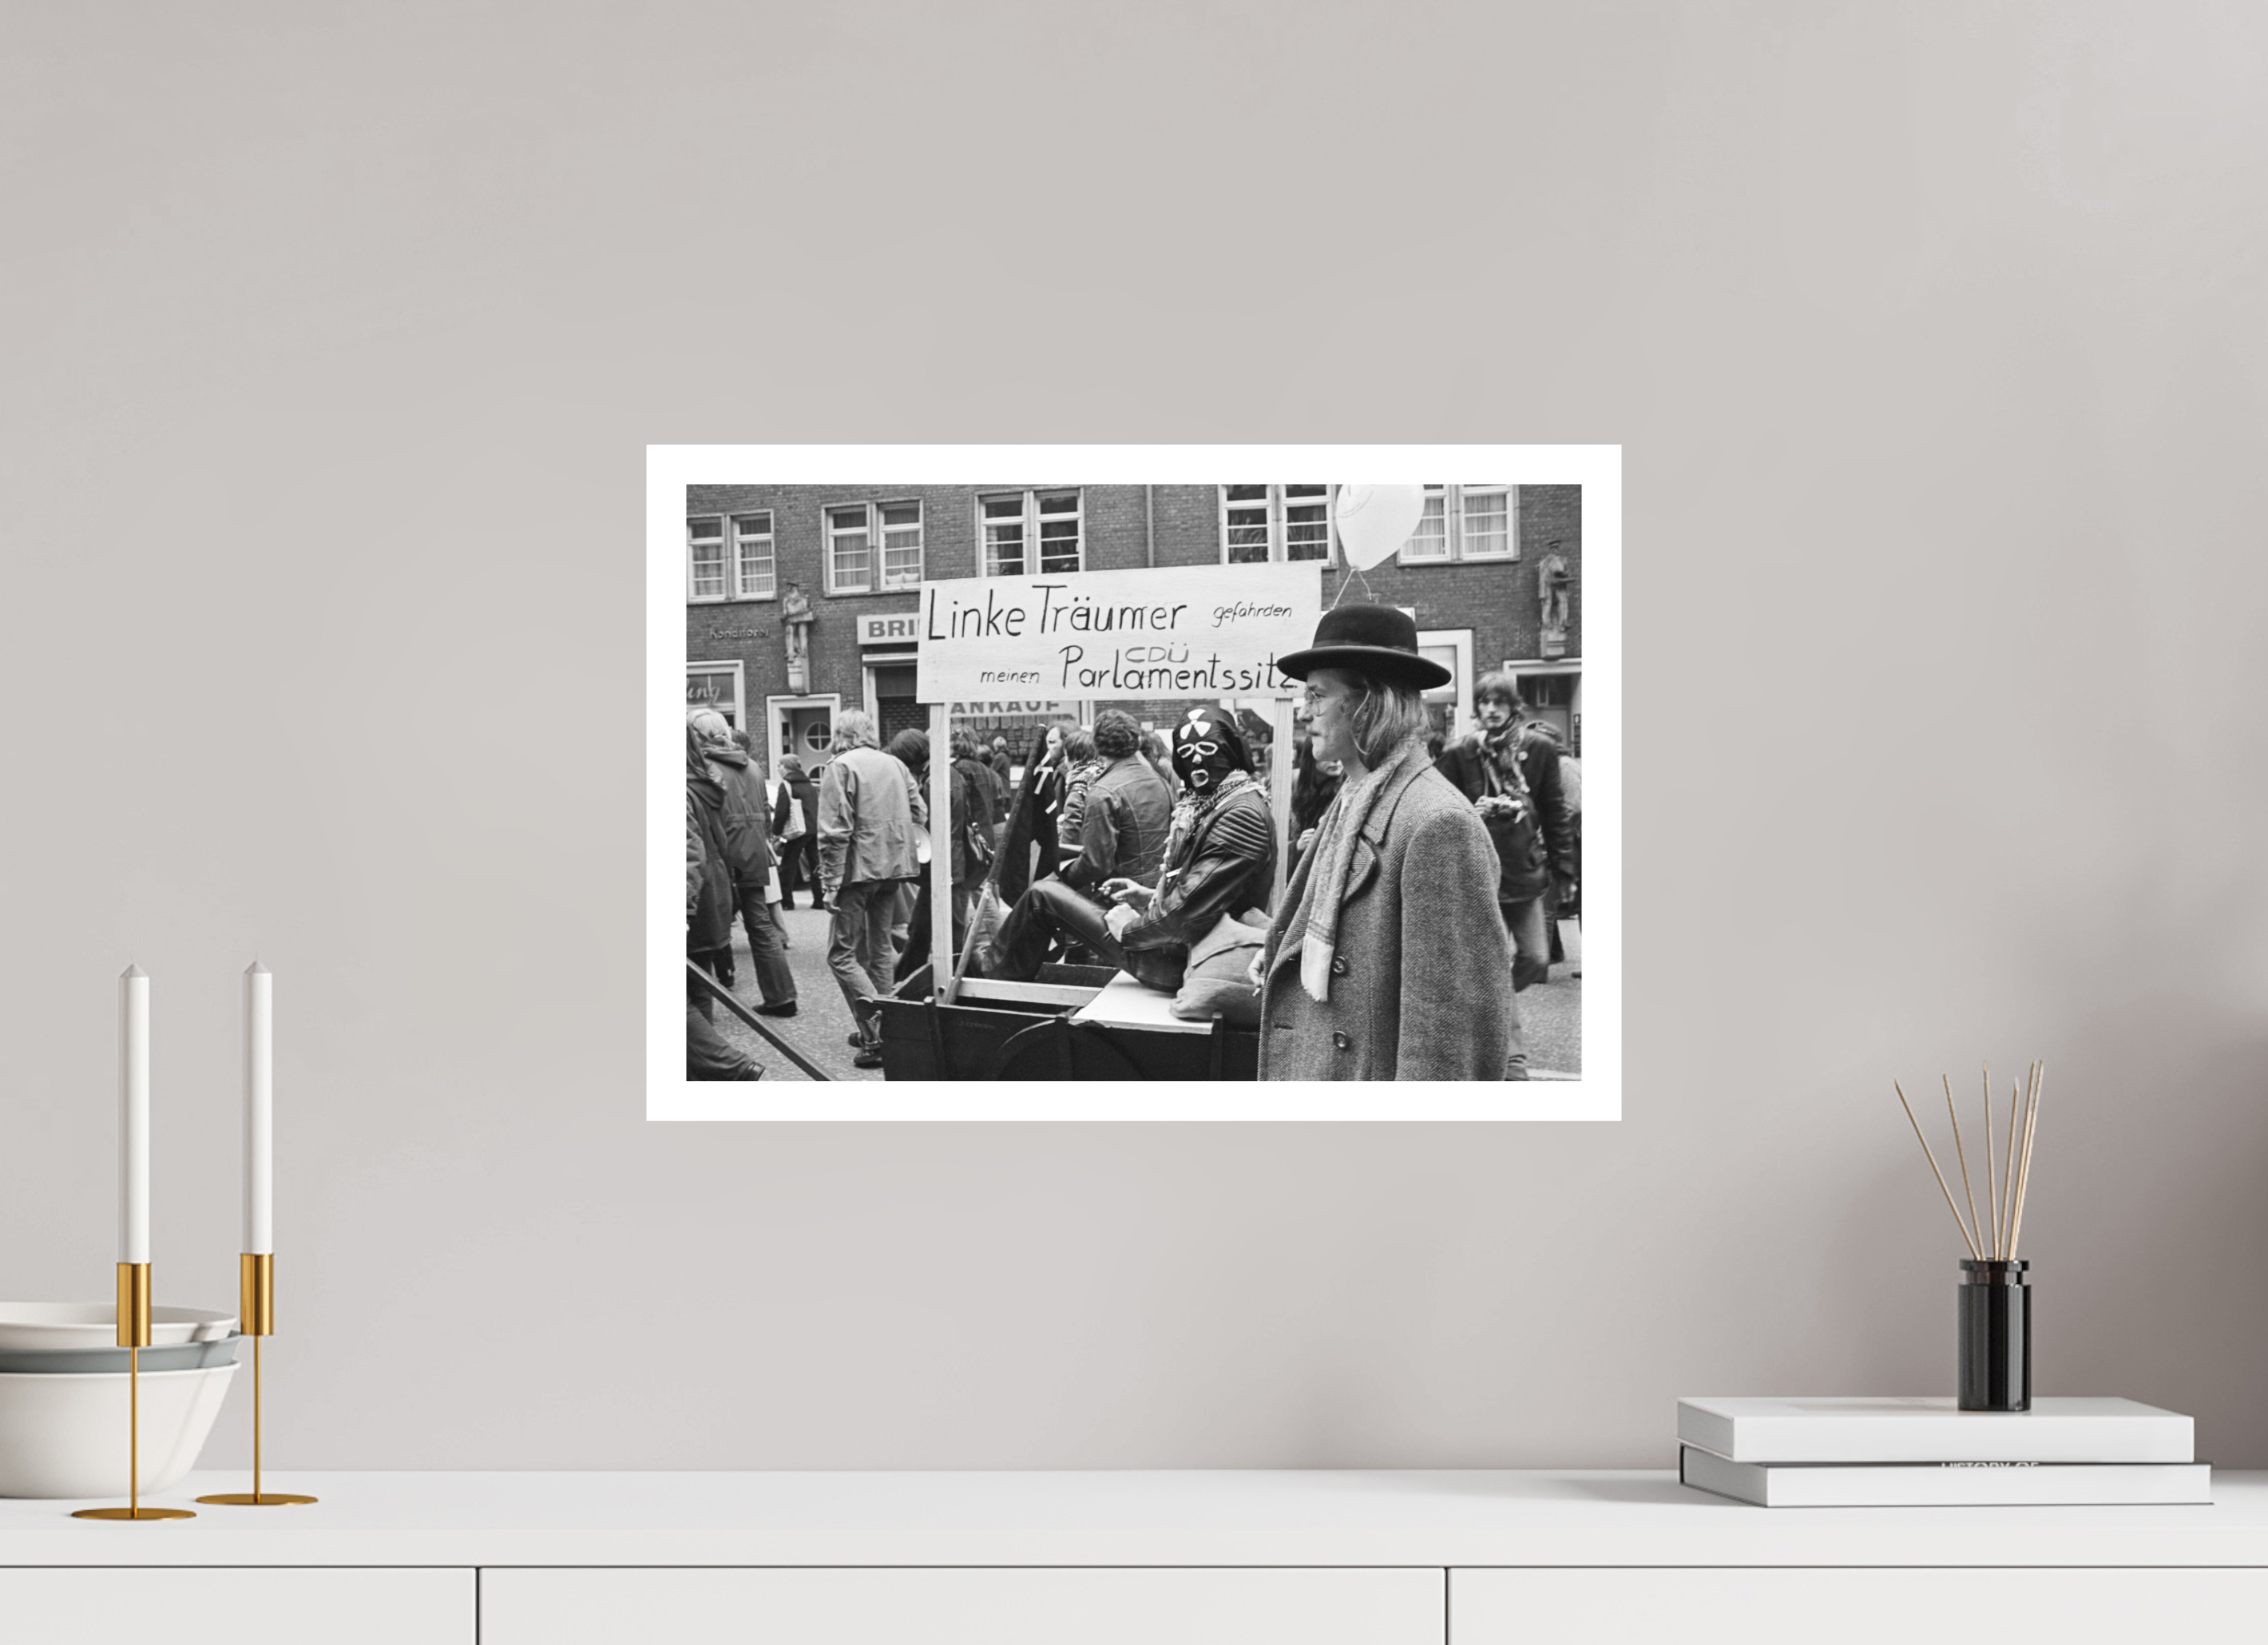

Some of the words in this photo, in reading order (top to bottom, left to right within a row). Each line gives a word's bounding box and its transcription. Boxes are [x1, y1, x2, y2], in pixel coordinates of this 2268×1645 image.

[929, 589, 1025, 640] Linke
[1032, 585, 1188, 633] Träumer
[1211, 601, 1292, 628] gefährden
[868, 619, 920, 637] BRI
[980, 668, 1040, 683] meinen
